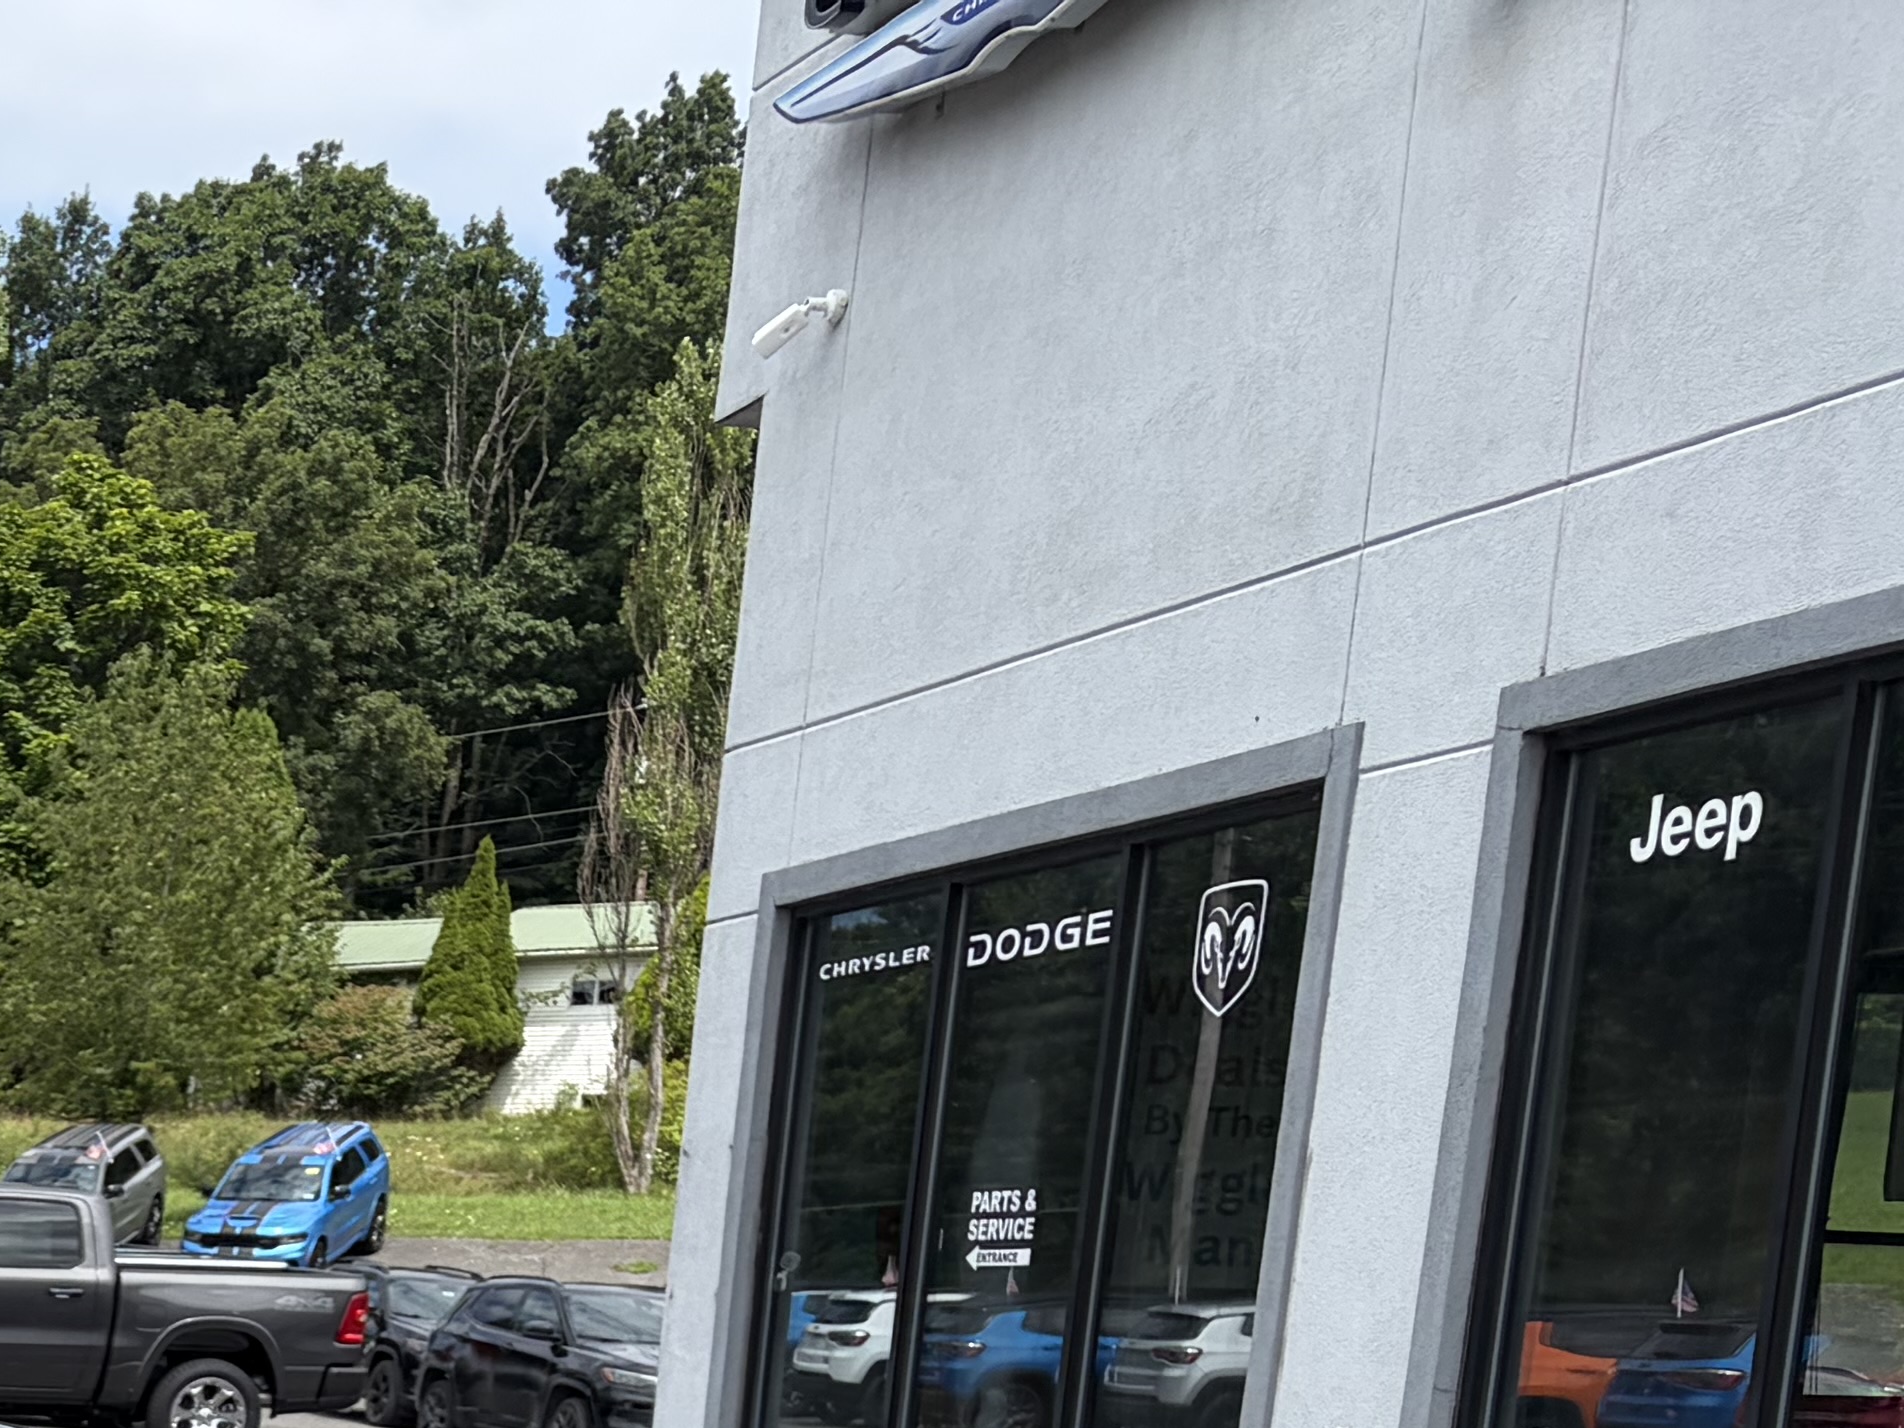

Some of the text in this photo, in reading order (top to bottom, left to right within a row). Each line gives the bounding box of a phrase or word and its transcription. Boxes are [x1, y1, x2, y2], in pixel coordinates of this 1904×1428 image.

[1630, 791, 1763, 863] Jeep
[966, 909, 1114, 968] DODGE
[819, 945, 931, 980] CHRYSLER
[971, 1189, 1037, 1213] PARTS &
[967, 1217, 1035, 1240] SERVICE
[976, 1251, 1018, 1263] ENTRANCE
